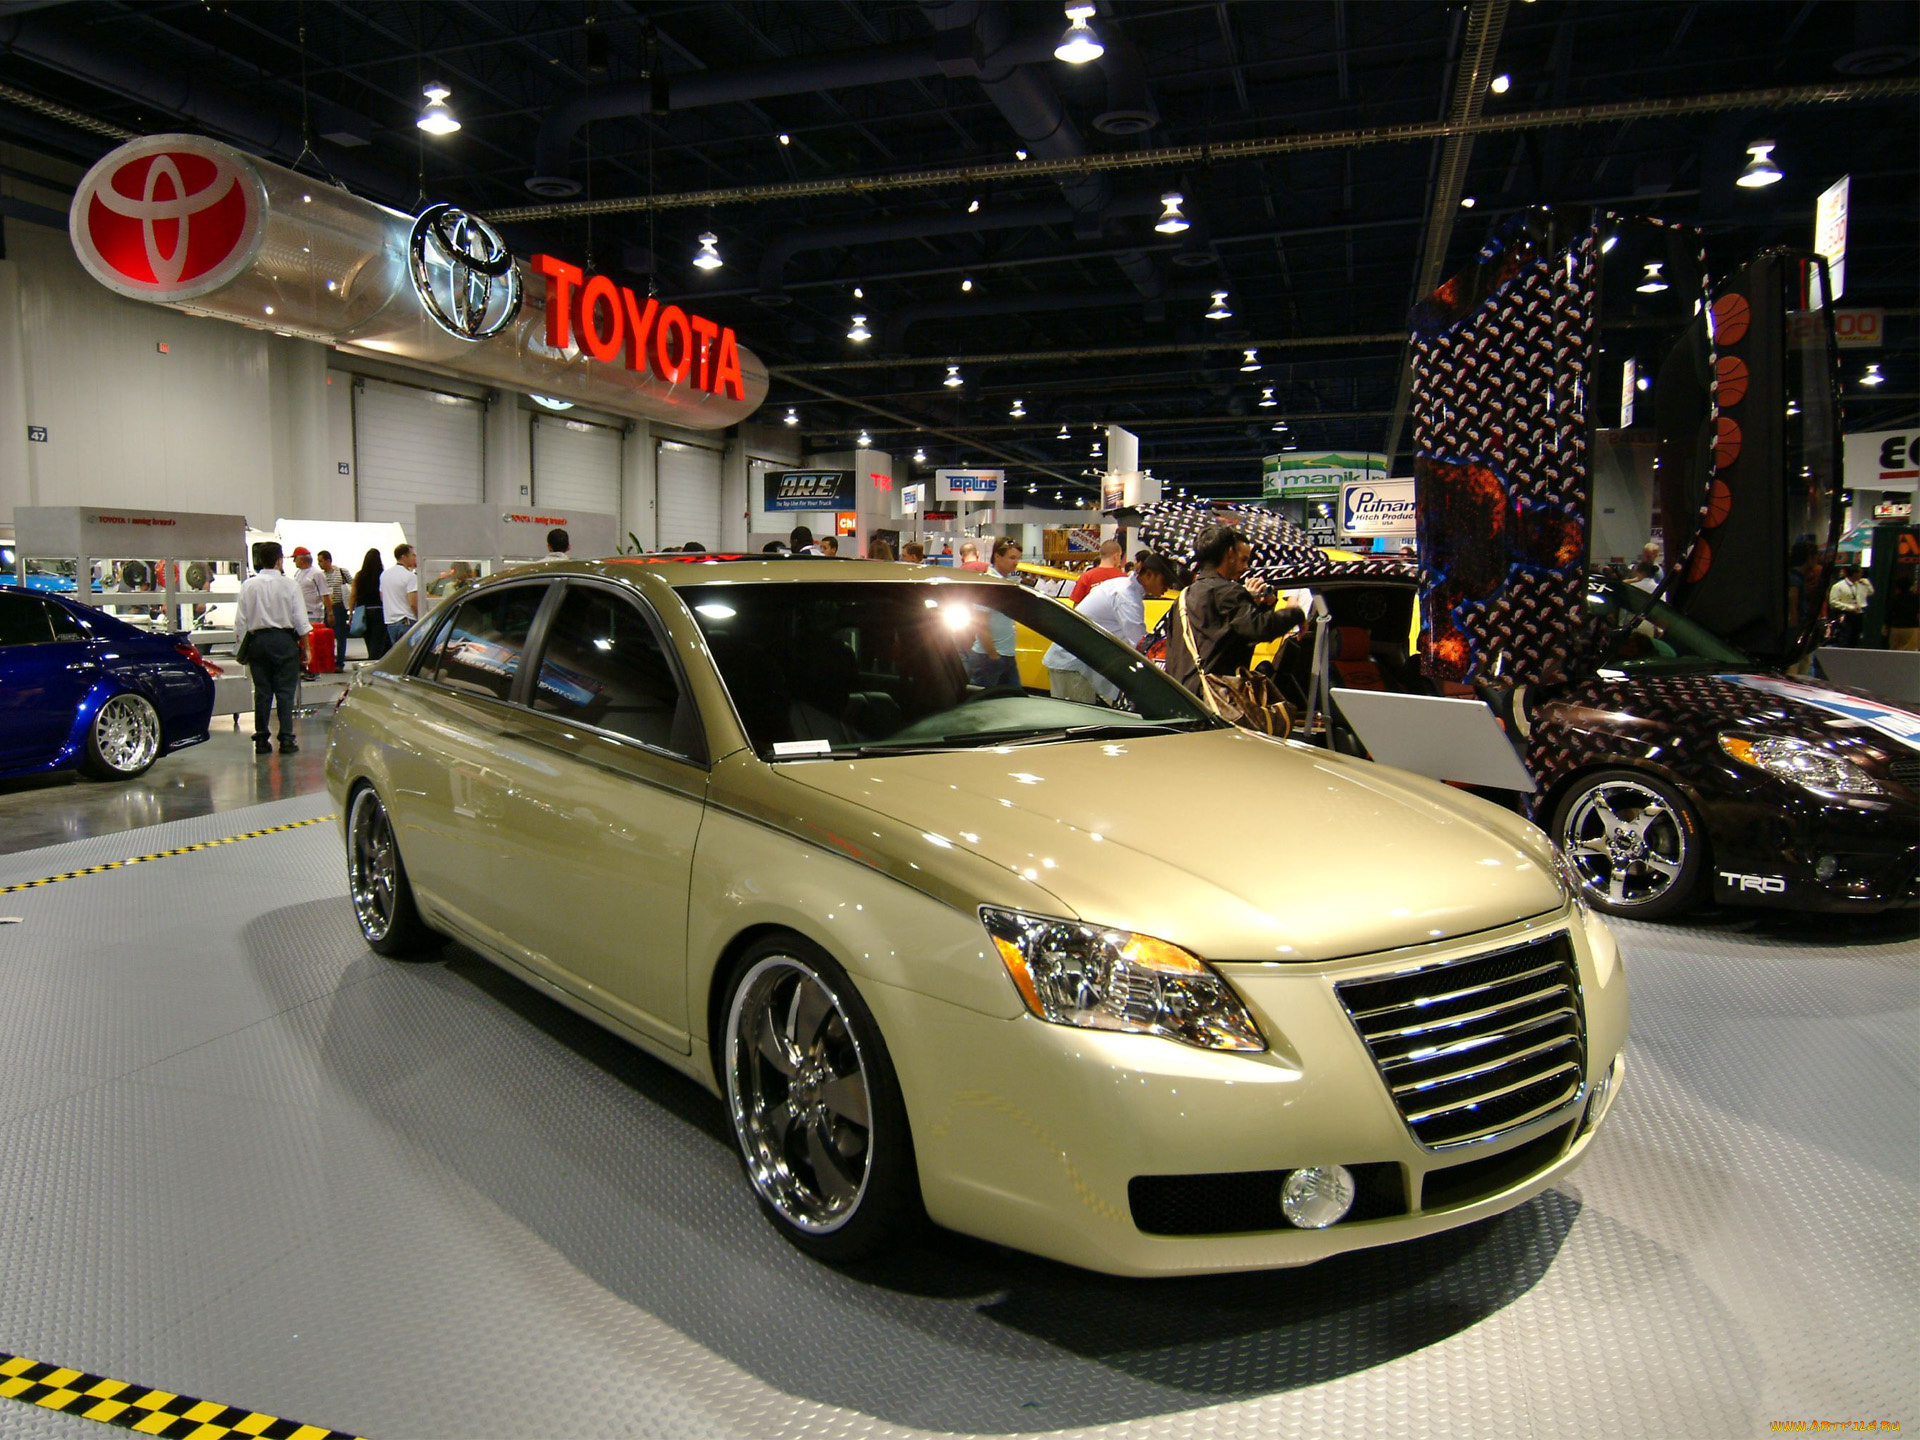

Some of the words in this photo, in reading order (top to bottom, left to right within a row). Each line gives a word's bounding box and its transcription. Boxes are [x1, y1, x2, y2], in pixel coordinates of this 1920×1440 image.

[531, 254, 745, 401] TOYOTA
[31, 432, 45, 441] 47
[1284, 471, 1360, 485] manik
[780, 476, 834, 496] A.R.E.
[99, 516, 126, 524] TOYOTA
[1356, 513, 1379, 521] Hitch
[1720, 872, 1785, 893] TRD
